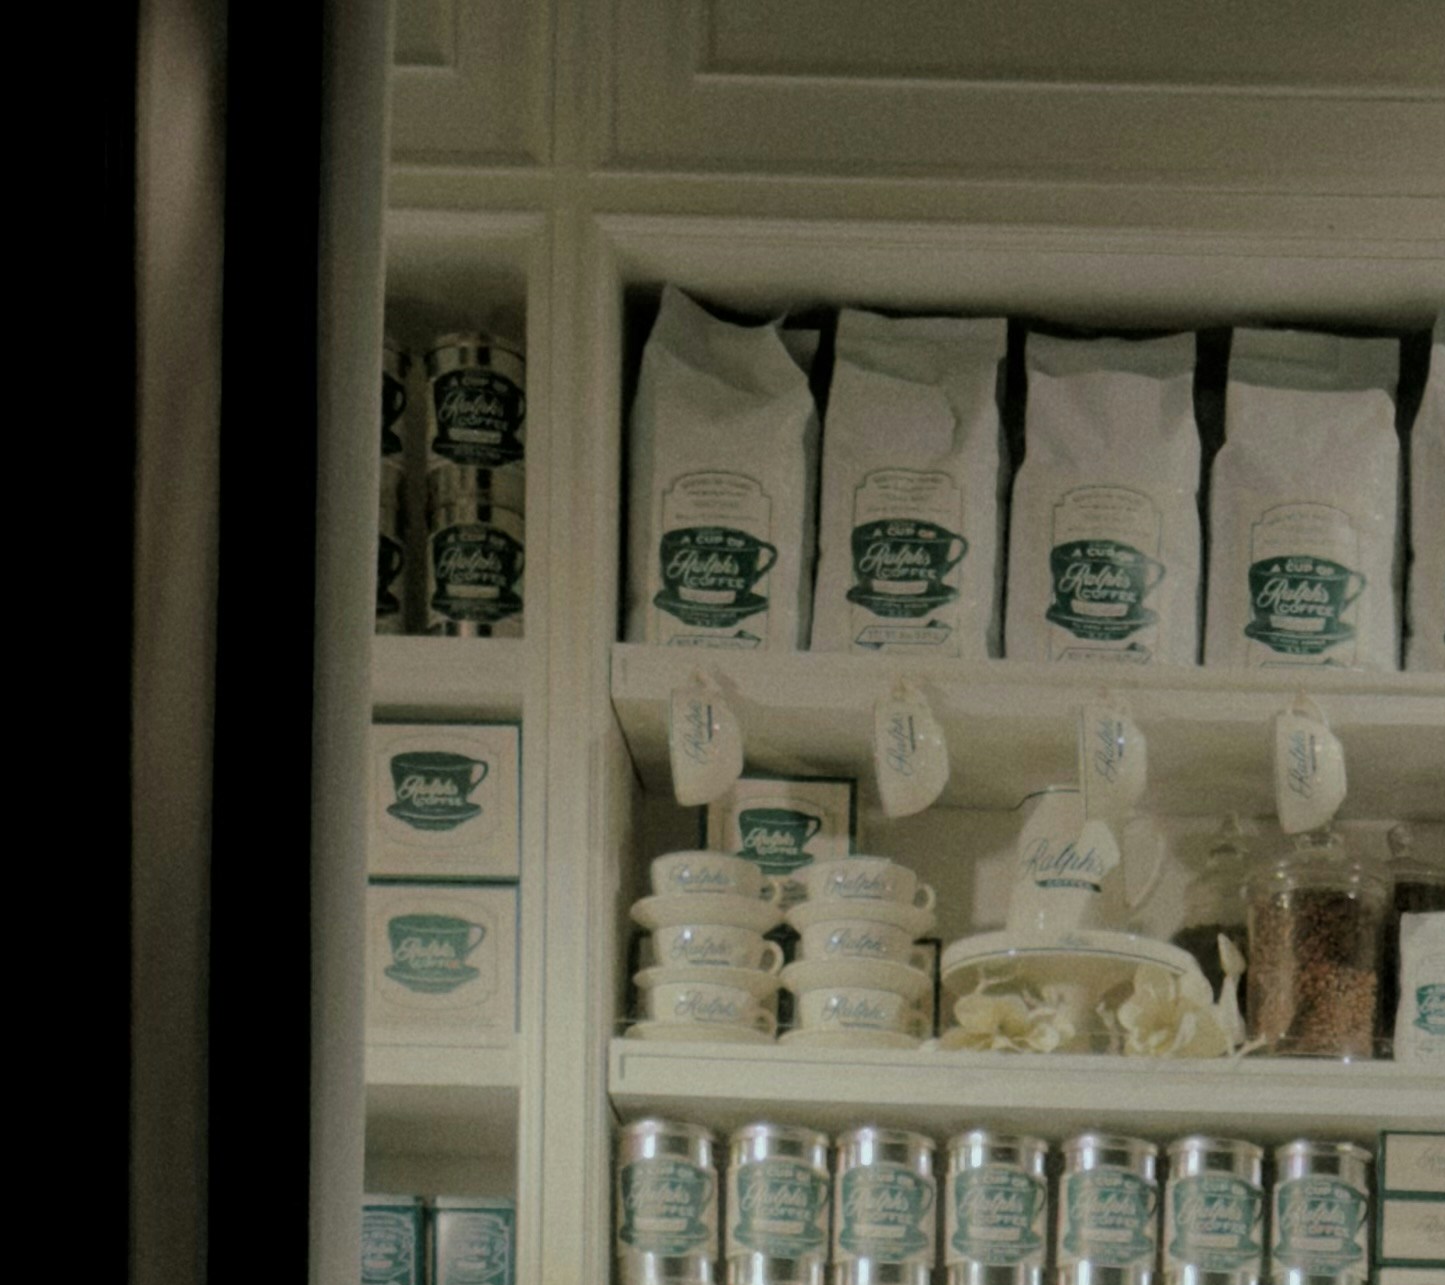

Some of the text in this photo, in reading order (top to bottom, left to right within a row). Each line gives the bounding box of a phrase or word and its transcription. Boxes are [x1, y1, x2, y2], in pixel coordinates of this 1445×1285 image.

[667, 550, 740, 581] Ralph's
[859, 541, 931, 572] Ralph's
[1058, 561, 1131, 592] Ralph's
[1256, 577, 1329, 609] Ralph's
